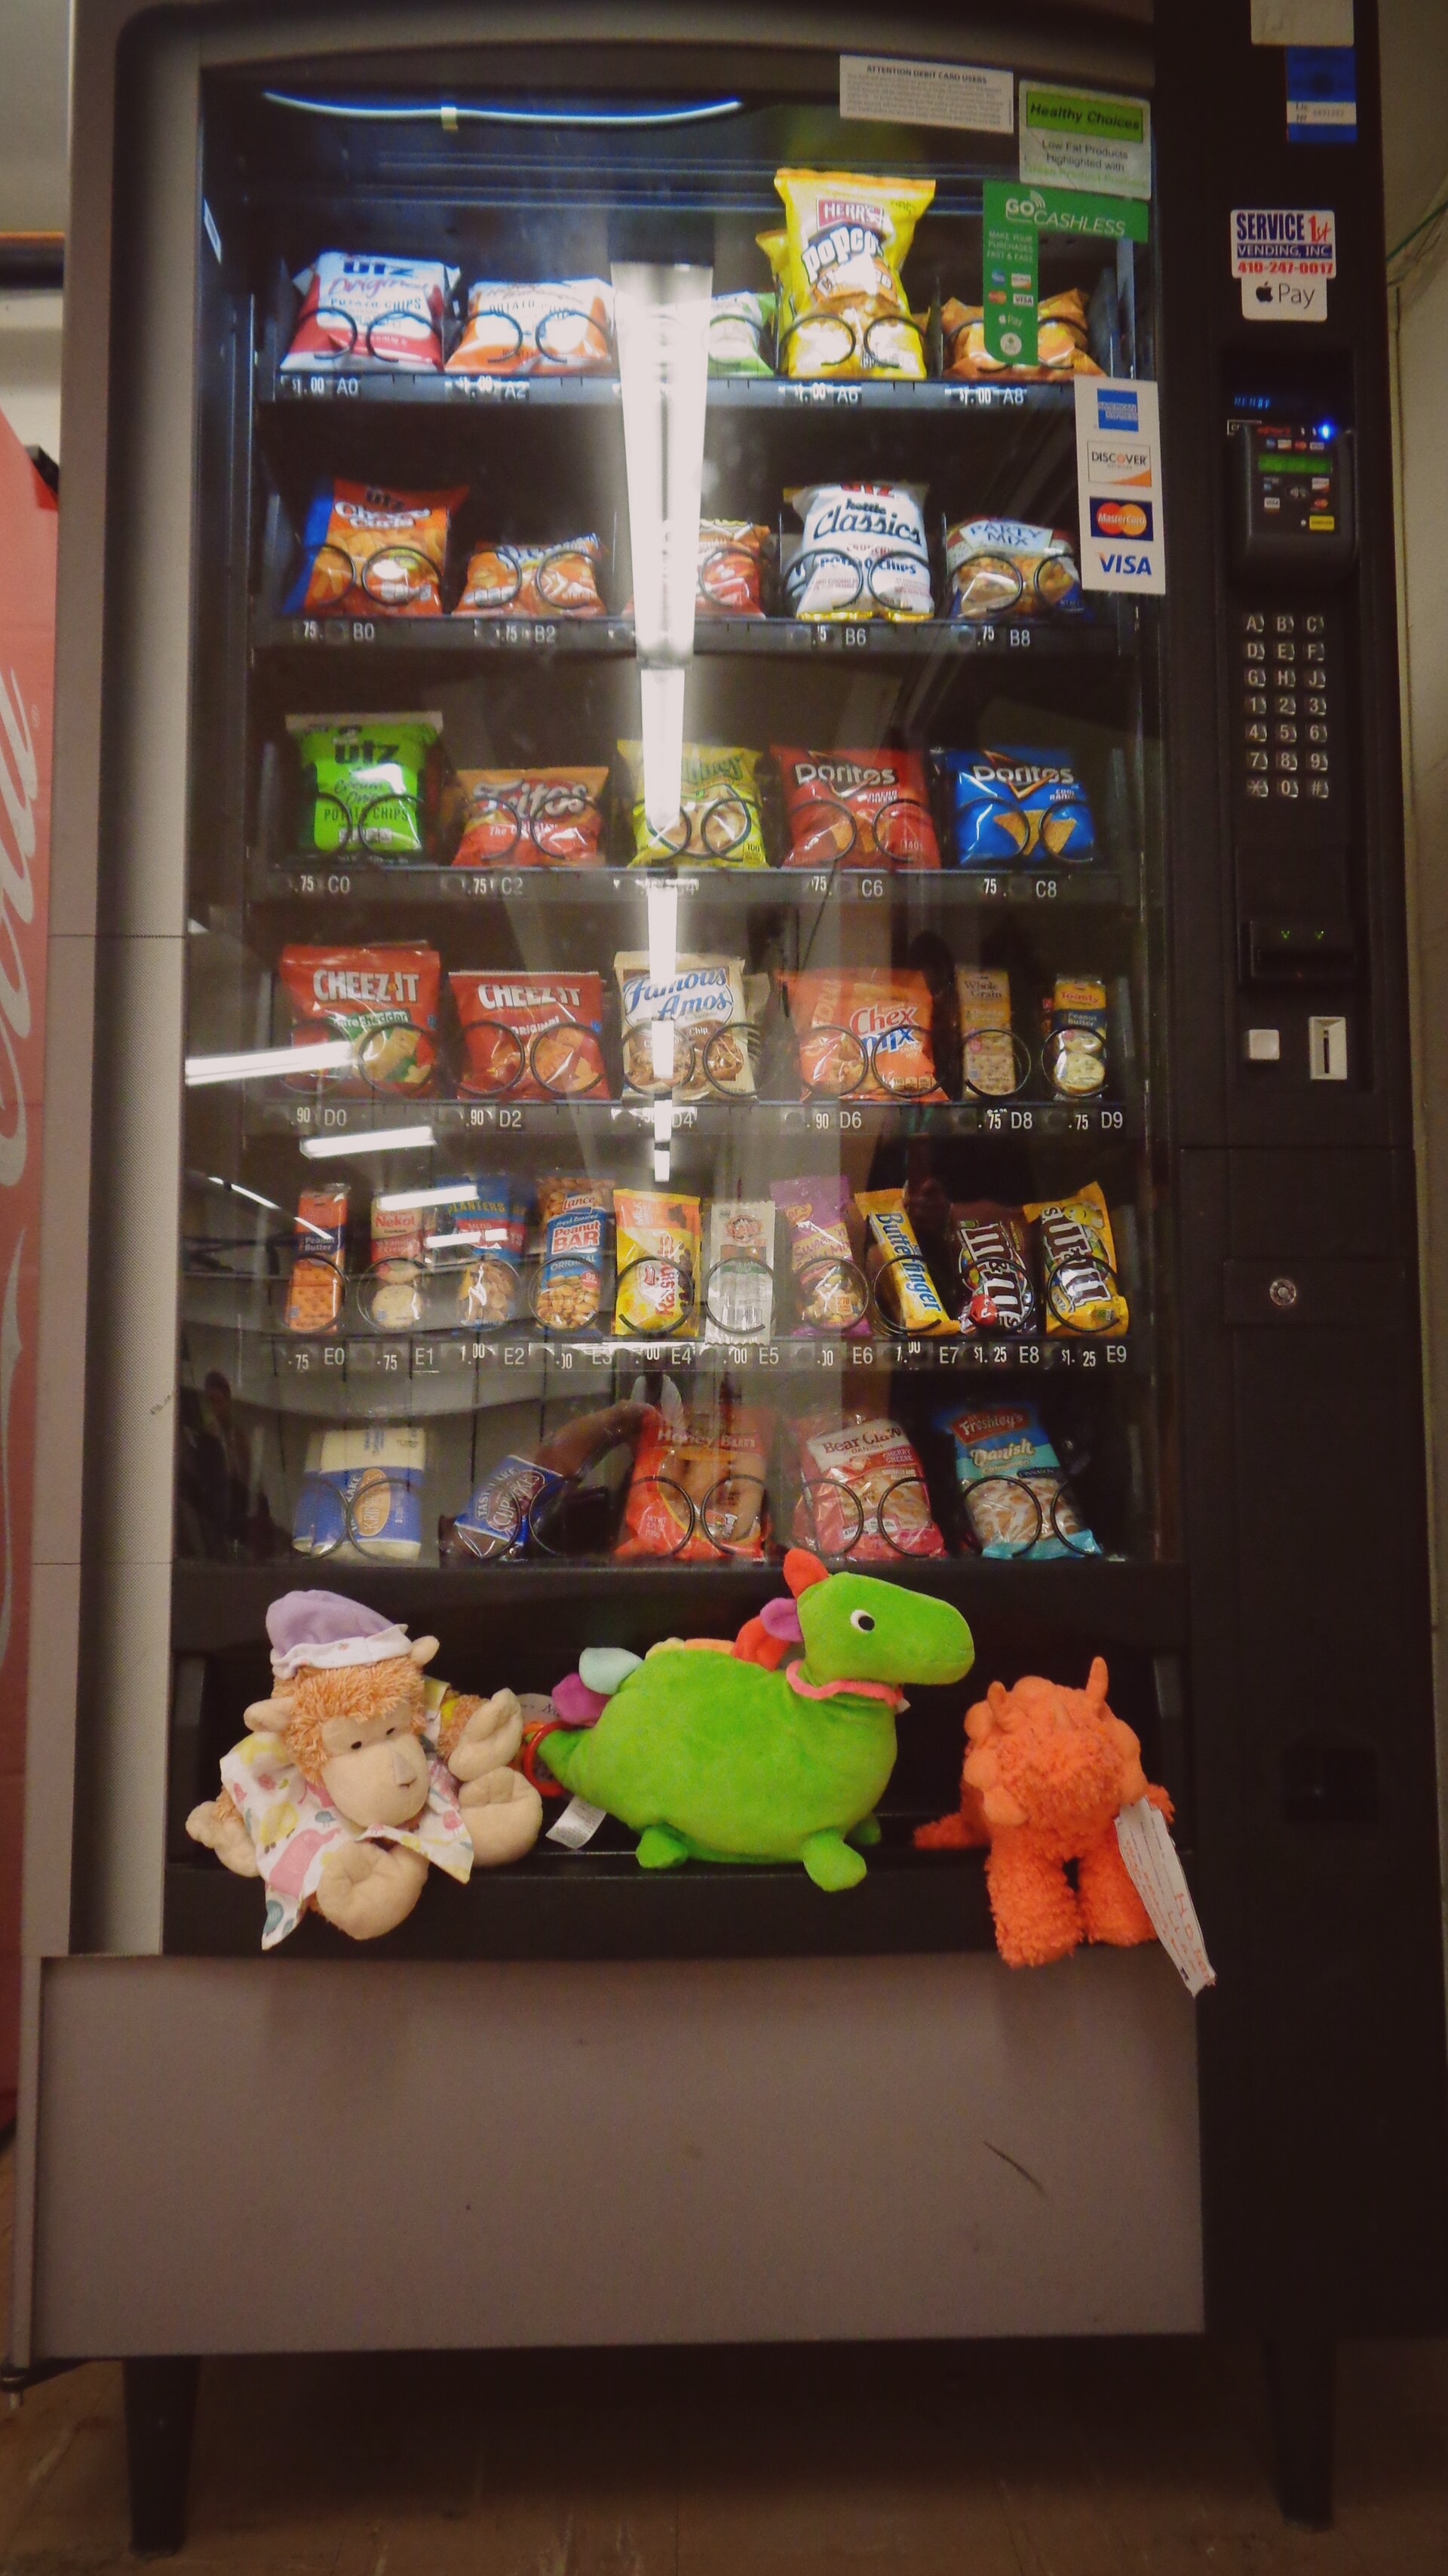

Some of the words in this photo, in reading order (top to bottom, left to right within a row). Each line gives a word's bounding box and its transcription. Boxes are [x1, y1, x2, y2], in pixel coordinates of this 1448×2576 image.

[867, 65, 912, 77] ATTENTION
[937, 72, 960, 81] CARD
[962, 74, 988, 85] USERS
[1030, 103, 1081, 123] Healthy
[1087, 110, 1140, 130] Choices
[1042, 139, 1063, 151] Low
[1066, 142, 1081, 152] Fat
[1084, 144, 1128, 160] Products
[1046, 152, 1103, 168] Highlighted
[1105, 161, 1125, 172] with
[824, 201, 876, 223] HERR'S
[1005, 198, 1035, 217] GO
[1034, 209, 1126, 237] CASHLESS
[988, 230, 1008, 240] MAKE
[1013, 233, 1032, 243] YOUR
[1236, 213, 1305, 241] SERVICE
[1308, 215, 1331, 243] 1st
[988, 240, 1033, 252] PURCHASES
[1238, 244, 1301, 257] VENDING,
[1305, 244, 1333, 256] INC.
[987, 250, 1005, 260] FAST
[1007, 253, 1013, 261] &
[1014, 253, 1033, 262] EASY
[1238, 261, 1333, 274] 410-247-0017
[385, 298, 422, 311] CHIPS
[1015, 296, 1033, 305] VISA
[1278, 283, 1315, 309] Pay
[1008, 314, 1022, 327] Pay
[338, 378, 359, 395] A0
[505, 384, 526, 399] A2
[837, 388, 858, 403] A6
[1003, 388, 1024, 405] A8
[1091, 450, 1147, 466] DISCOVER
[813, 504, 922, 547] Classics
[1097, 512, 1146, 526] MasterCard
[987, 532, 1027, 546] MIX
[1098, 554, 1152, 575] VISA
[353, 622, 375, 642] B0
[534, 625, 556, 642] B2
[845, 627, 867, 646] B6
[1010, 629, 1031, 647] B8
[794, 763, 896, 786] Doritos
[973, 765, 1074, 784] Doritos
[373, 807, 409, 821] CHIPS
[327, 875, 350, 894] C0
[501, 876, 523, 895] C2
[861, 879, 883, 897] C6
[1035, 880, 1057, 898] C8
[964, 980, 999, 991] Whole
[970, 988, 1003, 999] Grain
[1060, 990, 1099, 1004] Toasty
[658, 992, 733, 1021] Amos
[849, 1004, 919, 1035] Chex
[1067, 1012, 1097, 1021] Peanut
[1067, 1018, 1094, 1027] Butter
[689, 1026, 708, 1038] Chip
[324, 1108, 347, 1126] D0
[499, 1109, 522, 1127] D2
[840, 1111, 862, 1128] D6
[1011, 1112, 1033, 1130] D8
[1101, 1111, 1124, 1129] D9
[563, 1195, 595, 1210] Lance
[376, 1213, 416, 1228] Nekot
[554, 1220, 601, 1238] Peanut
[305, 1236, 335, 1244] Peanut
[552, 1231, 600, 1253] BAR
[324, 1347, 345, 1366] E0
[415, 1347, 434, 1365] E1
[505, 1348, 525, 1365] E2
[671, 1347, 692, 1364] E4
[759, 1347, 779, 1364] E5
[853, 1347, 873, 1364] E6
[940, 1346, 959, 1364] E7
[1019, 1346, 1040, 1363] E8
[1106, 1345, 1127, 1363] E9
[959, 1412, 1023, 1437] Freshley's
[657, 1428, 714, 1449] Honey
[720, 1434, 756, 1448] Bun
[822, 1435, 861, 1455] Bear
[862, 1426, 902, 1445] Claw
[851, 1443, 883, 1455] DANISH
[970, 1437, 1035, 1467] Danish
[885, 1454, 914, 1463] CHEESE
[983, 1458, 1030, 1474] Cinnamon
